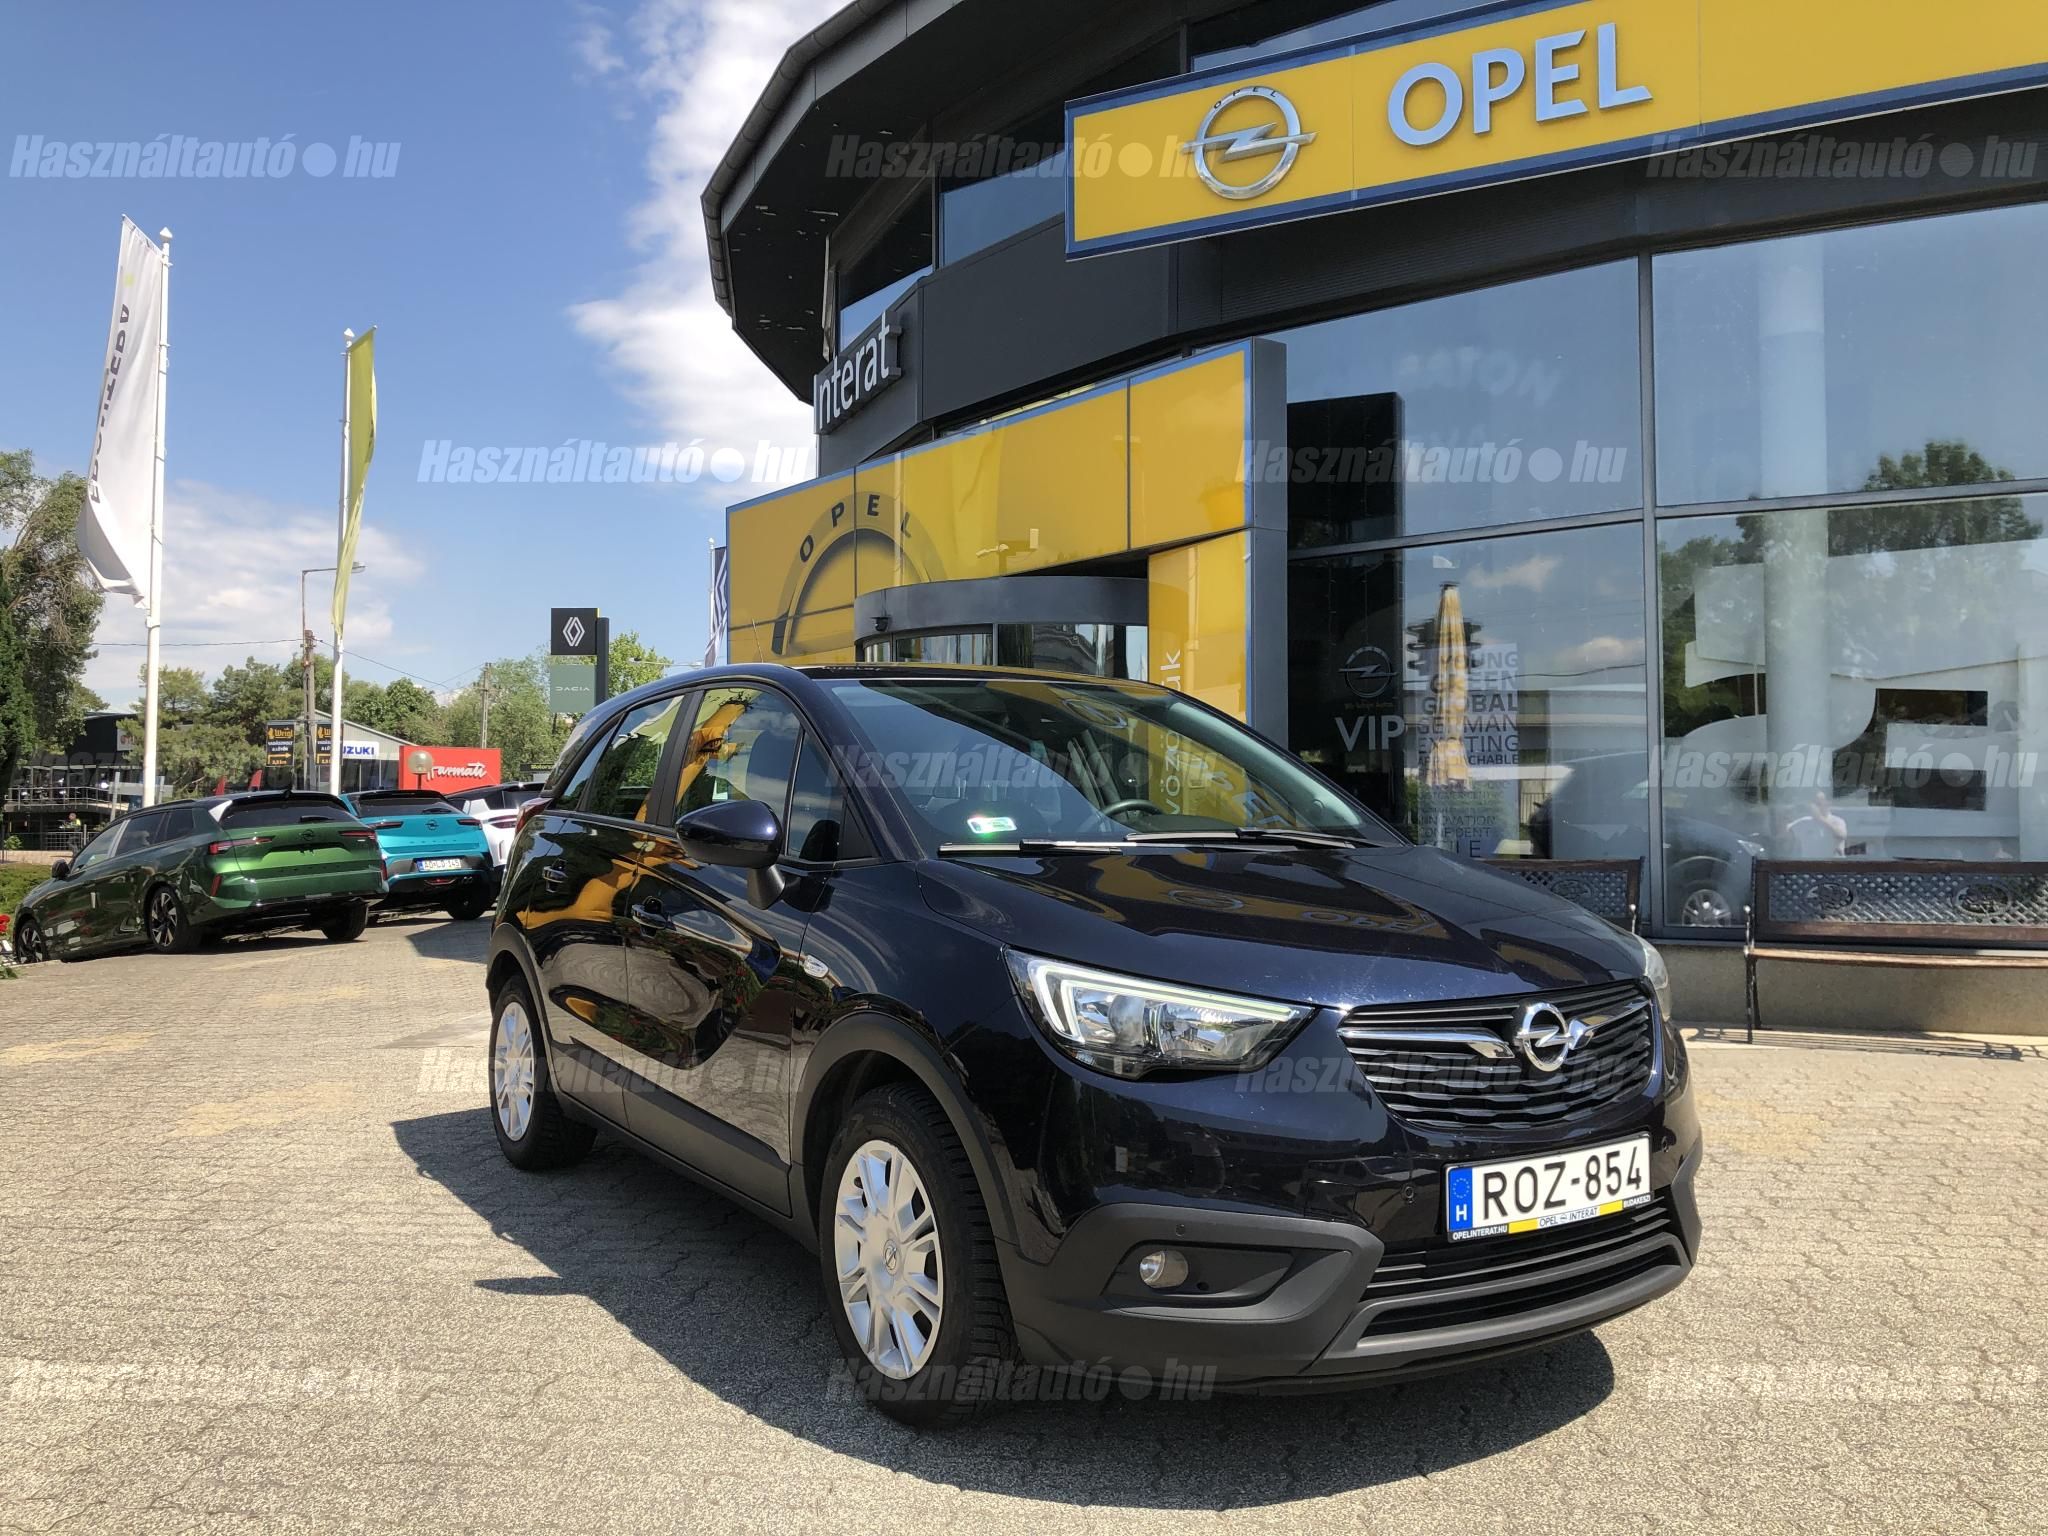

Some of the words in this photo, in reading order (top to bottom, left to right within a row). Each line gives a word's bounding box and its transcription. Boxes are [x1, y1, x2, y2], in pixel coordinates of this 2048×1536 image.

[1386, 22, 1653, 148] OPEL
[1214, 86, 1278, 109] OPEL
[814, 310, 893, 433] Interat
[800, 494, 912, 563] OPEL
[1422, 693, 1519, 715] GBAL
[1335, 715, 1405, 752] VIP
[1418, 714, 1519, 734] GEMAN
[343, 746, 375, 755] UZUKI
[1418, 735, 1519, 754] EXTING
[1483, 1146, 1642, 1220] ROZ-854
[1455, 1203, 1468, 1222] H
[1539, 1216, 1559, 1227] OPEL
[1569, 1207, 1599, 1222] INTERAT
[1452, 1224, 1508, 1241] OPELINTERAT.HU
